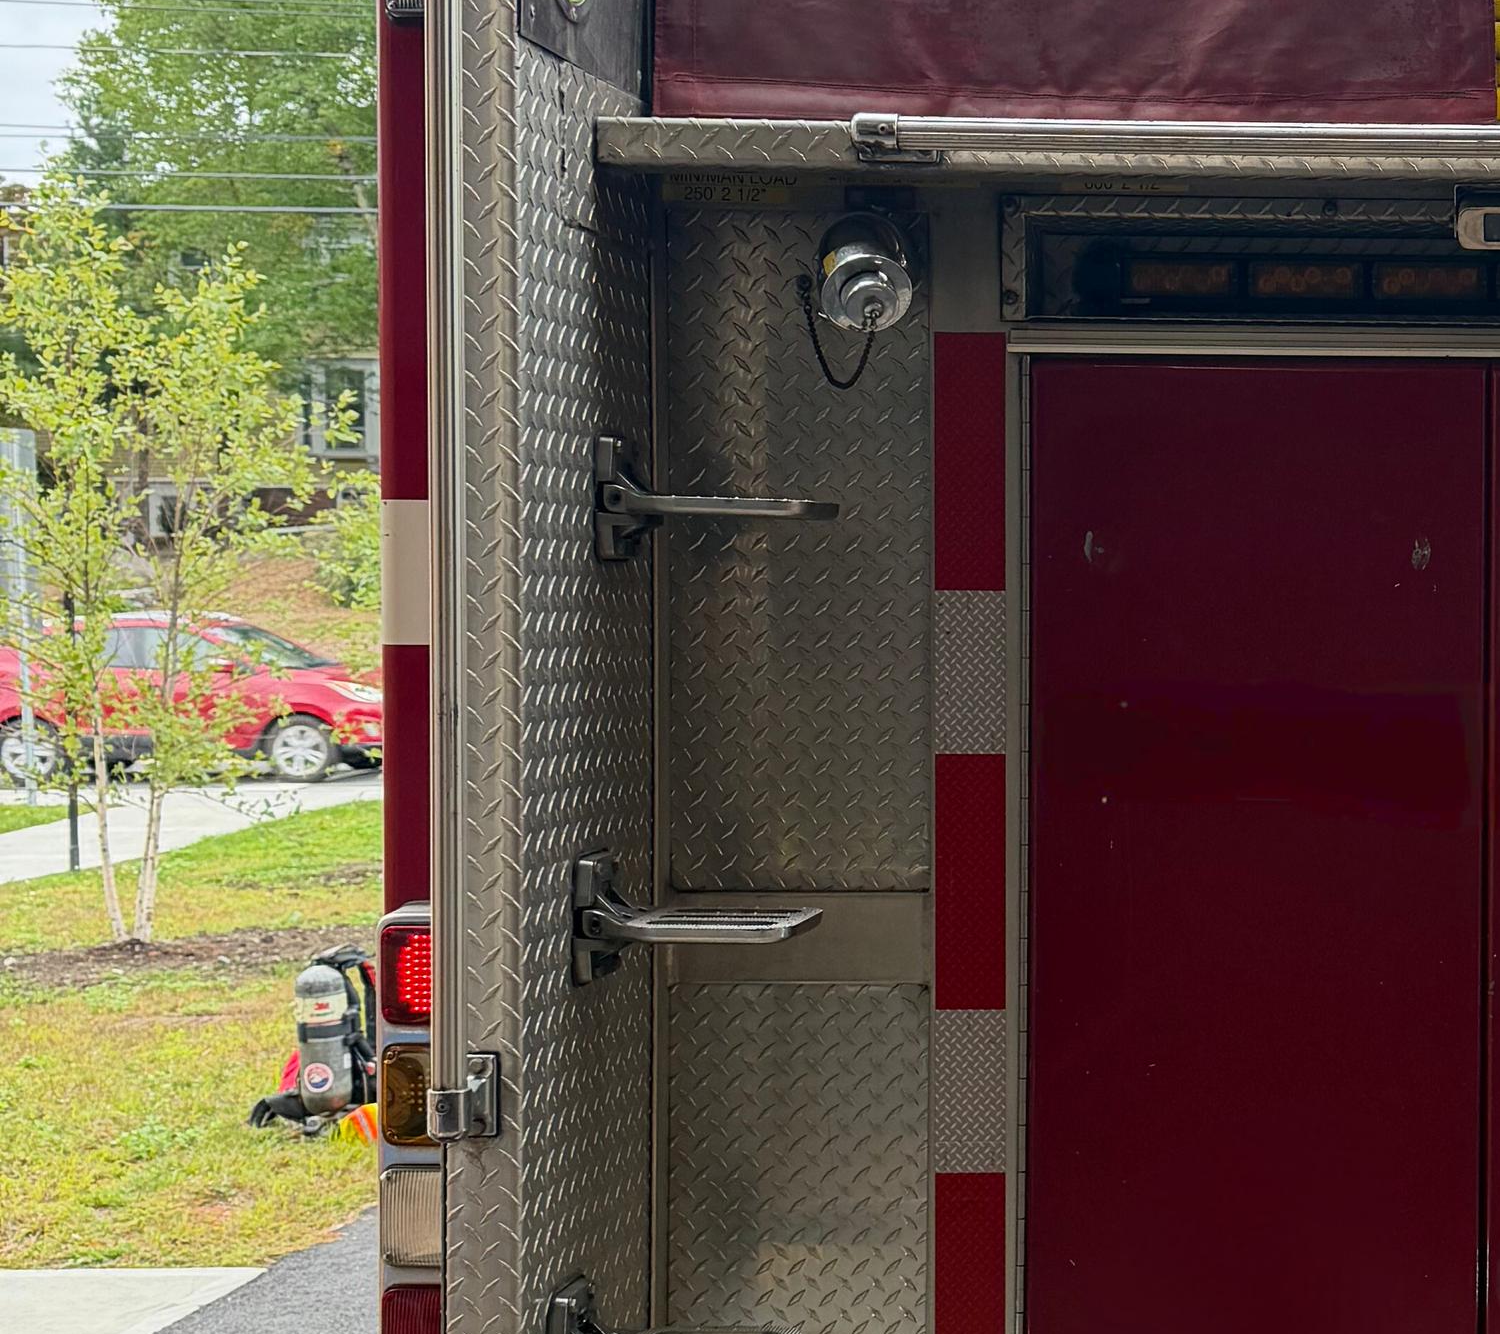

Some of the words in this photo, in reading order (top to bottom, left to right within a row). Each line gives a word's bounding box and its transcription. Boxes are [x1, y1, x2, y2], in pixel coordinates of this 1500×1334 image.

[684, 187, 716, 201] 250'
[721, 188, 731, 201] 2
[739, 188, 766, 201] 1/2"
